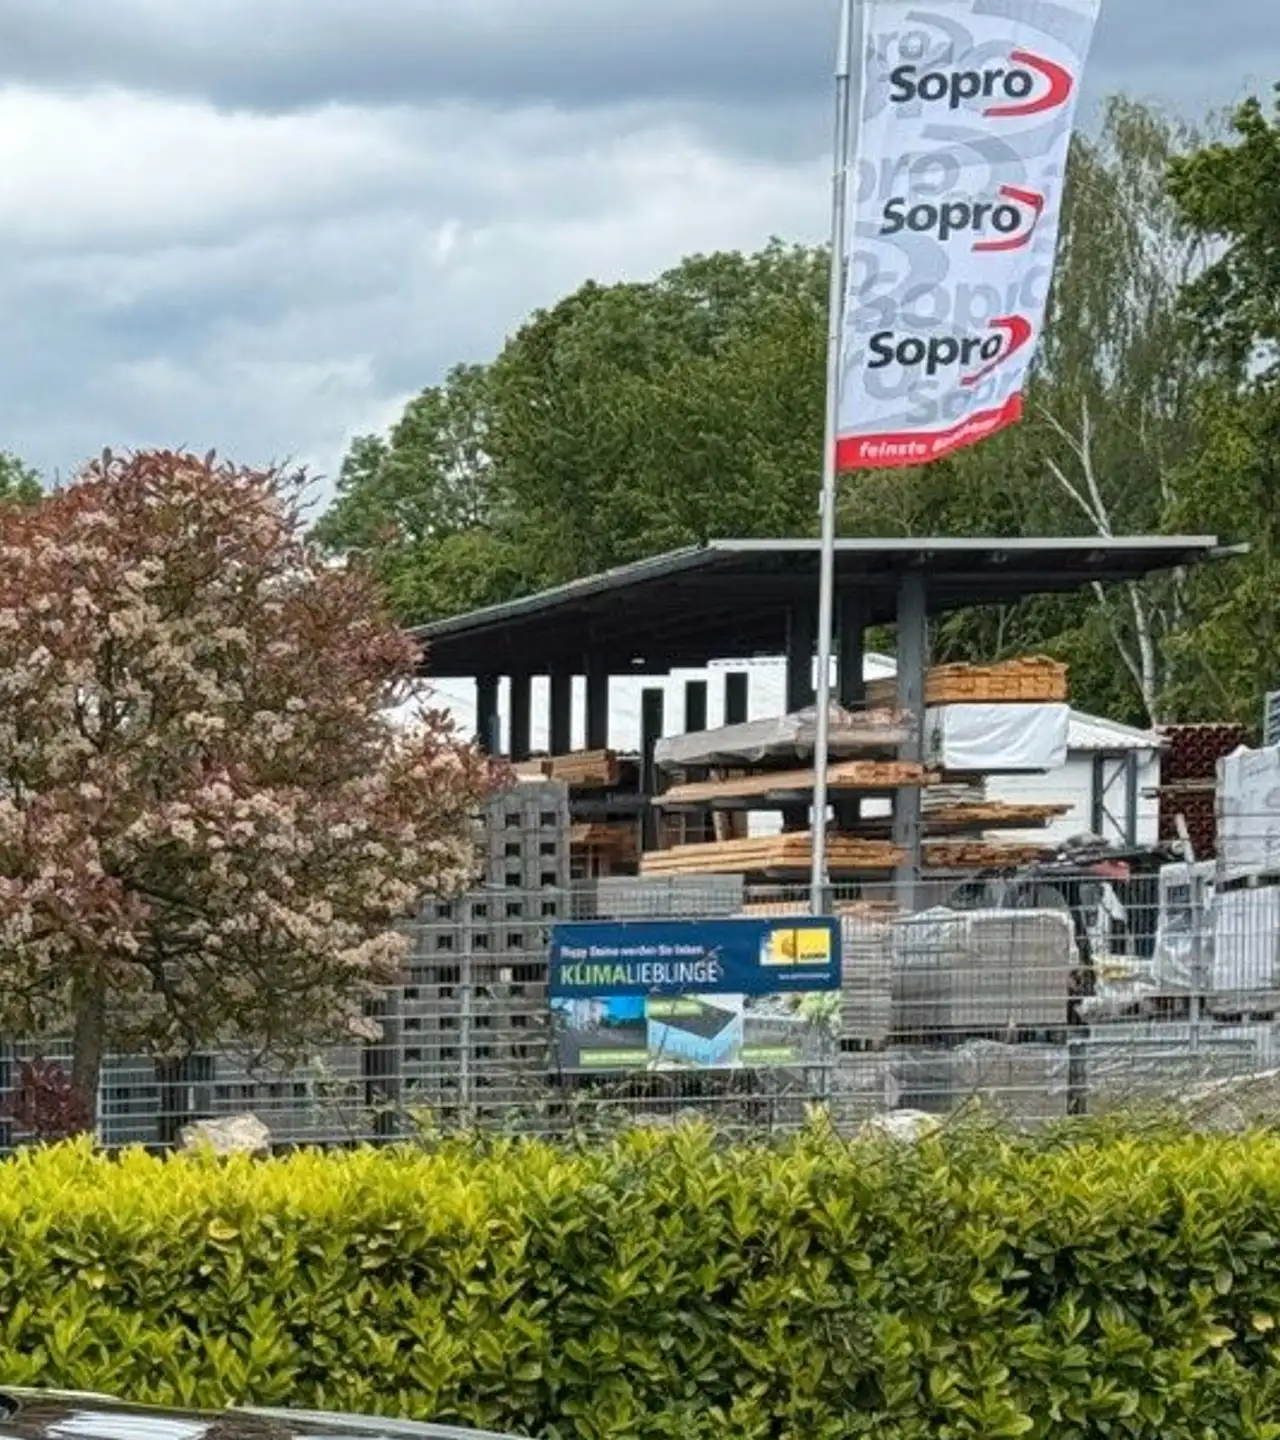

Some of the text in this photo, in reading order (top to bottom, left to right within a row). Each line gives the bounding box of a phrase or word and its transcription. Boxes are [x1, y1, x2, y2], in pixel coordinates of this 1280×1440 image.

[889, 65, 1034, 108] Sopro
[879, 197, 1022, 240] Sopro
[867, 330, 1004, 375] Sopro
[859, 441, 928, 458] feinste
[560, 960, 719, 986] KLIMALIEBLINGE
